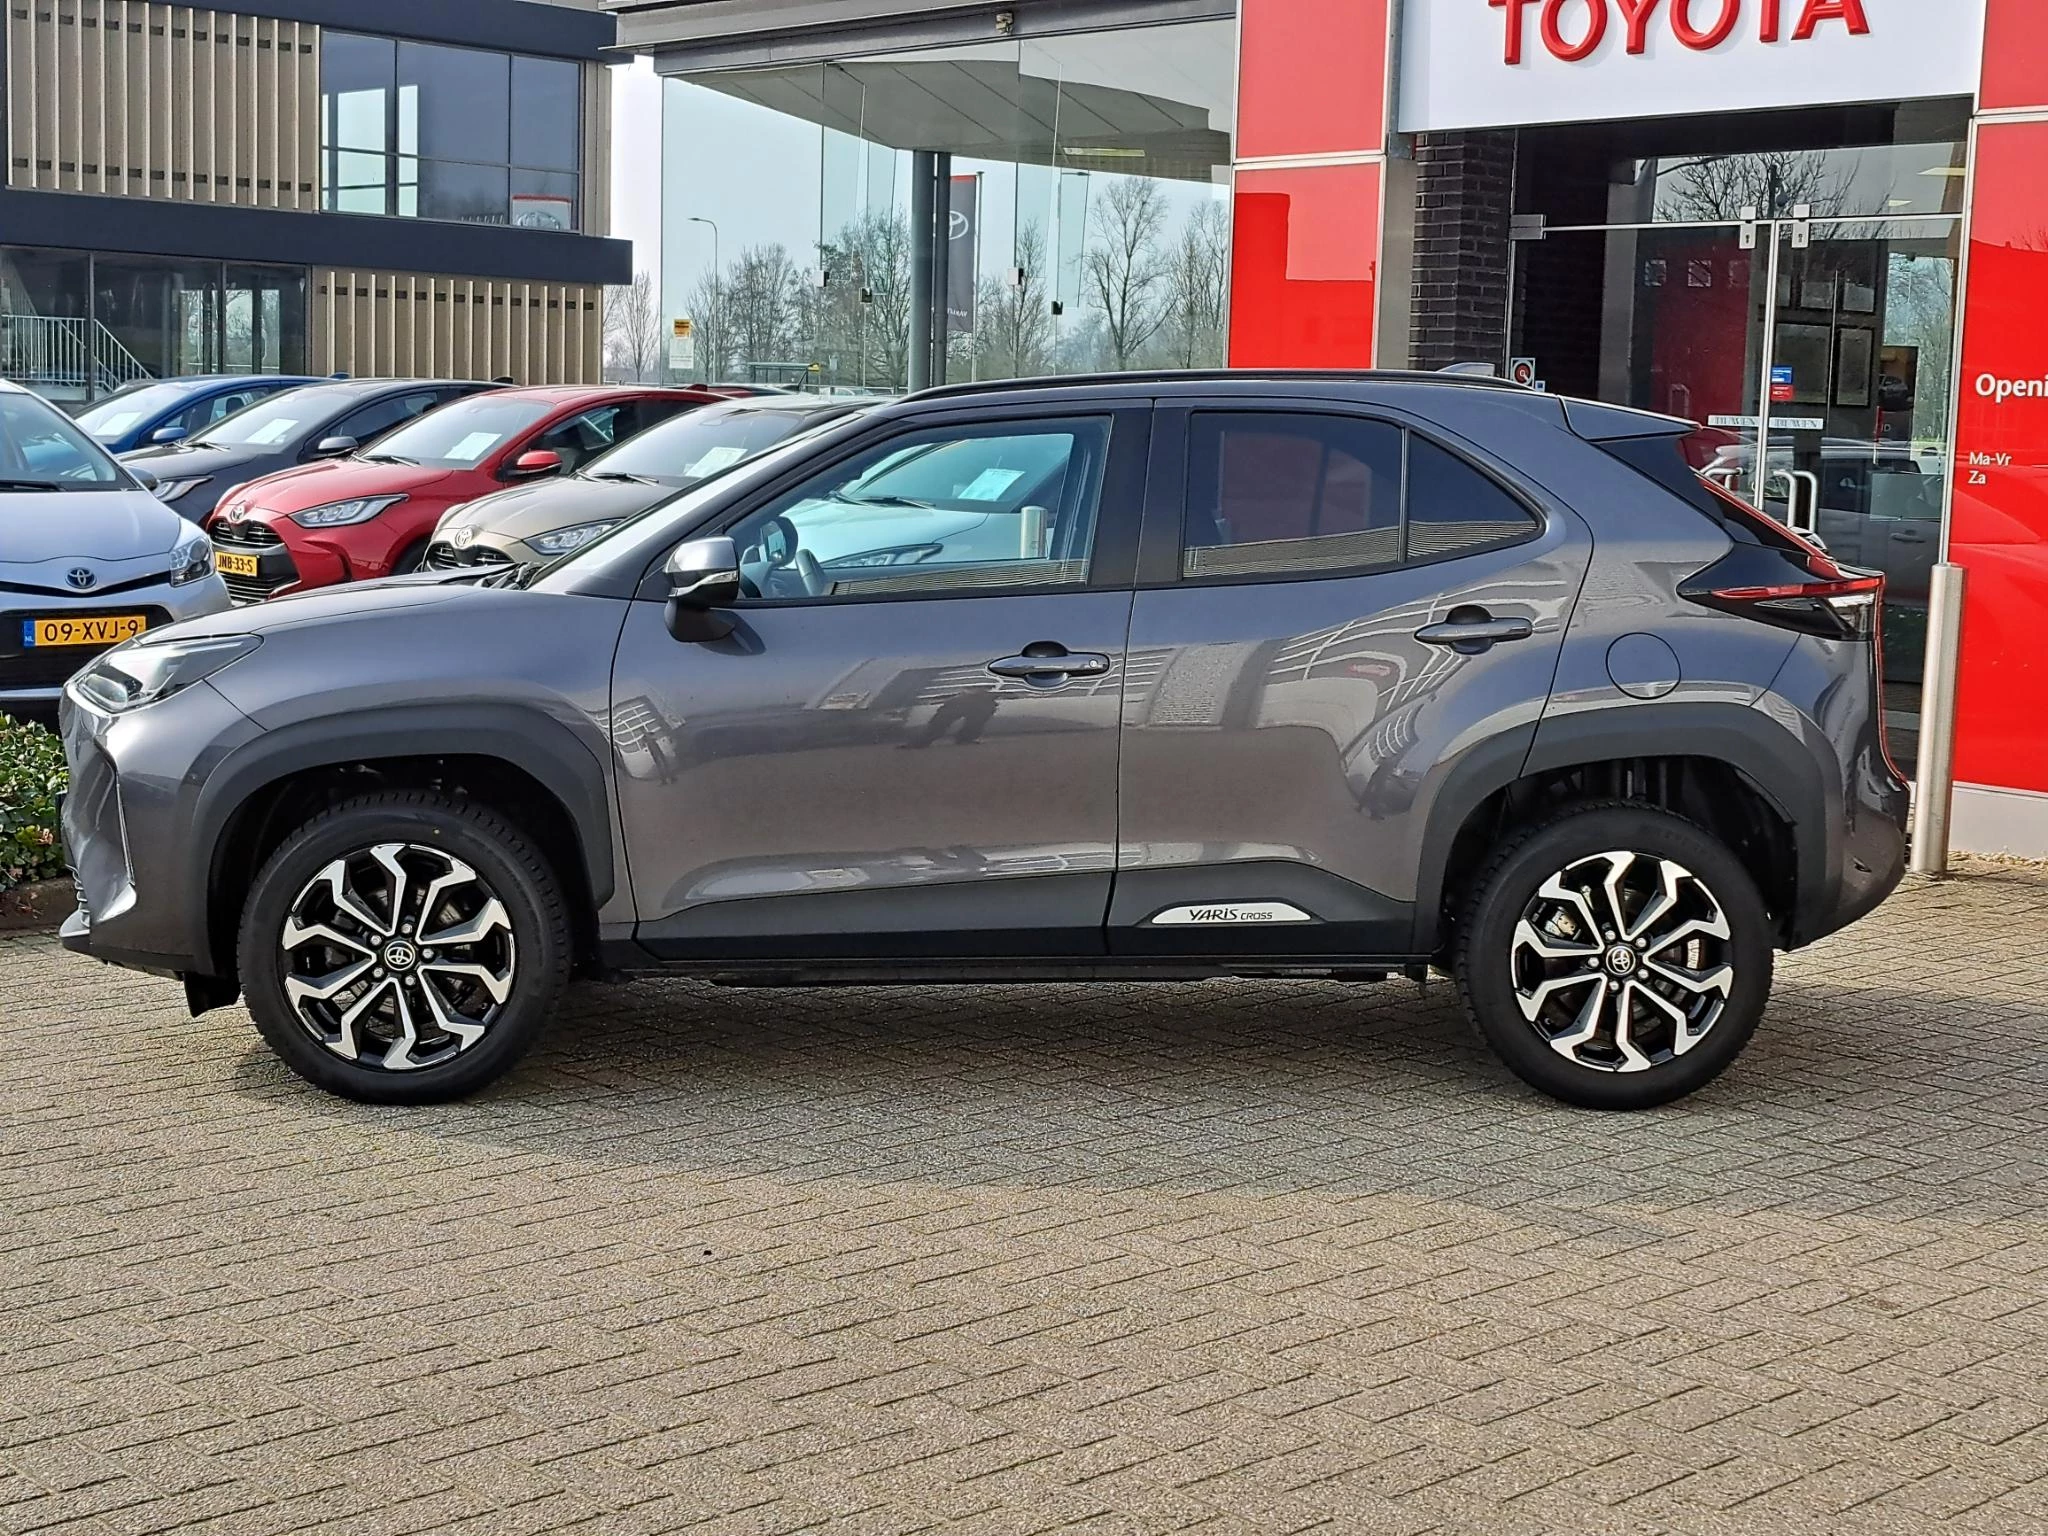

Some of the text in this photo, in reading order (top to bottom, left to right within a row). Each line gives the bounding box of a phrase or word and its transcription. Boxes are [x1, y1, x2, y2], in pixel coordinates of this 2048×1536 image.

[1488, 0, 1870, 65] TOYOTA
[1975, 373, 2048, 403] Openi
[1968, 451, 2012, 466] Ma-Vr
[1967, 470, 1986, 484] Za
[44, 619, 139, 642] 09-XVJ-9
[1240, 911, 1273, 921] CROSS
